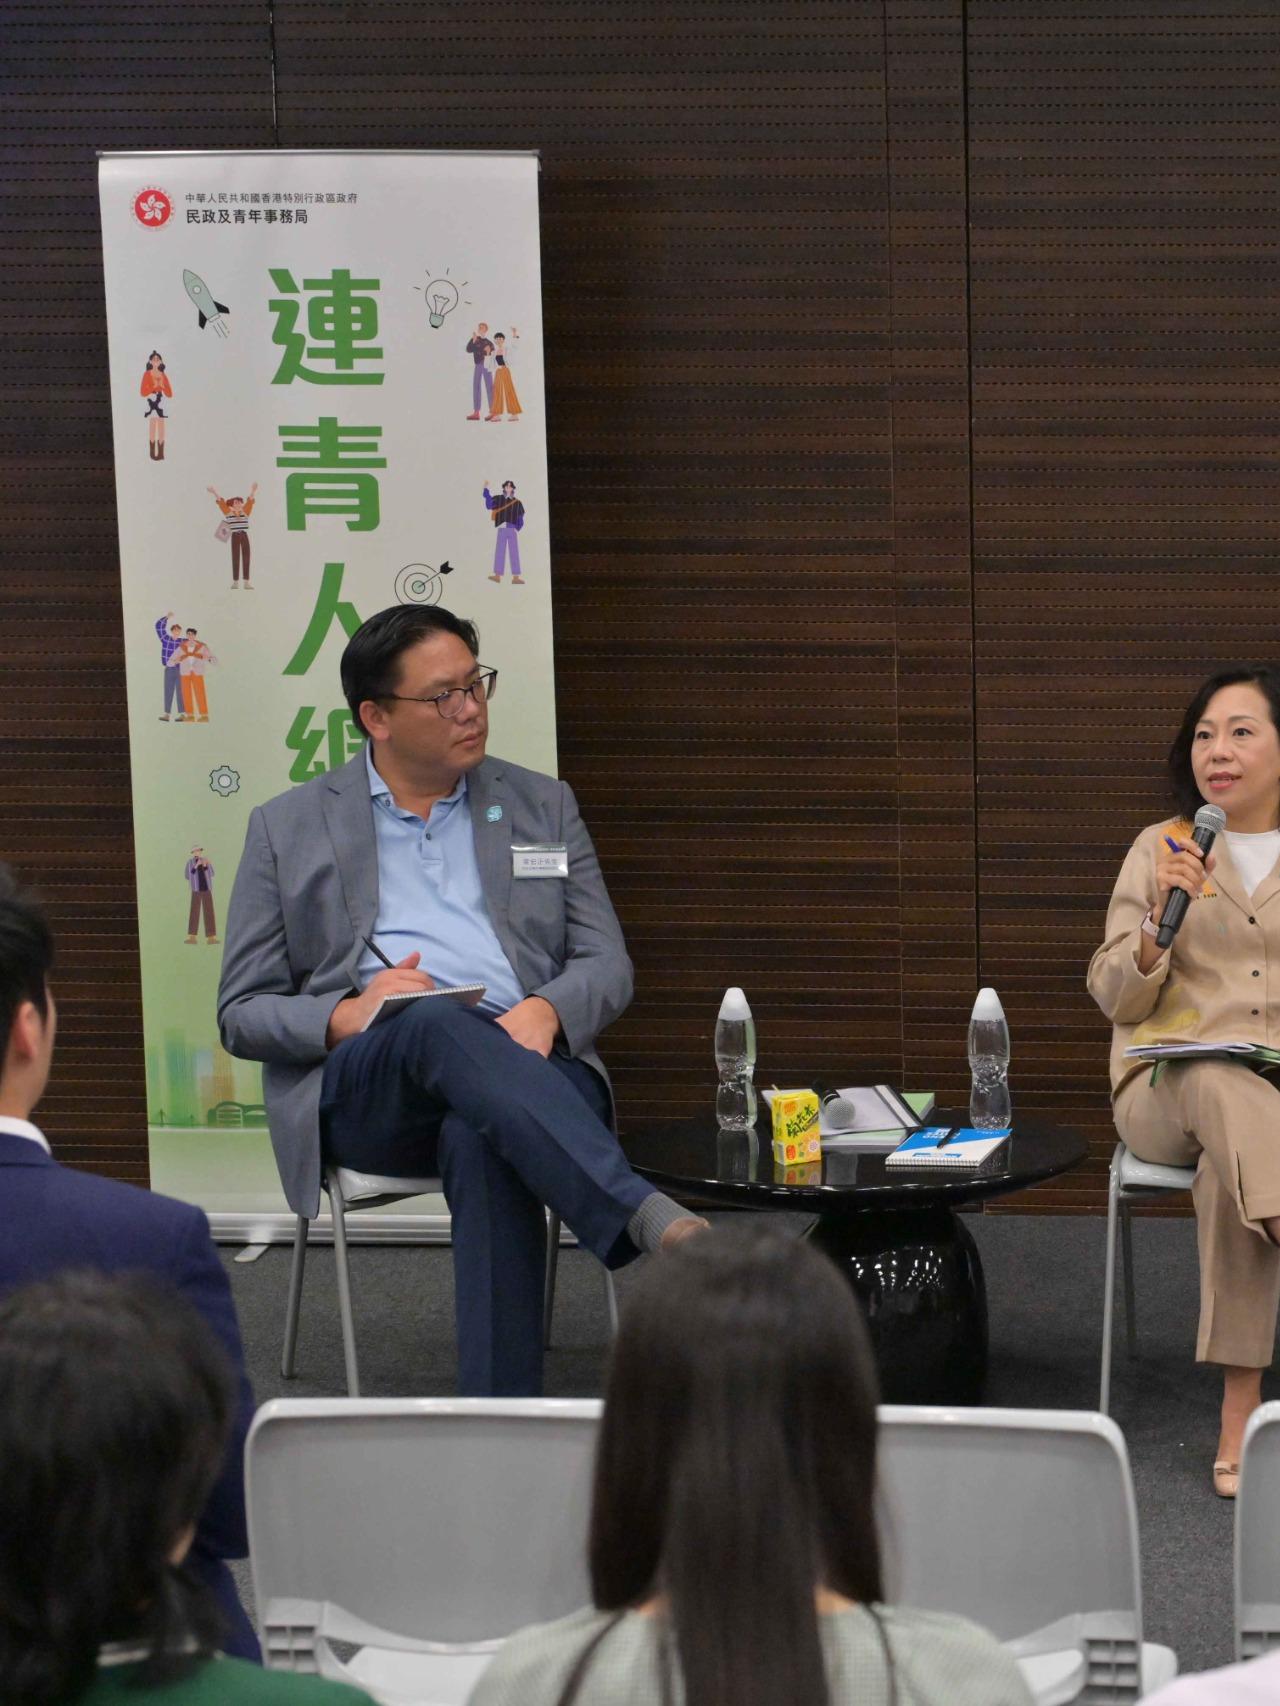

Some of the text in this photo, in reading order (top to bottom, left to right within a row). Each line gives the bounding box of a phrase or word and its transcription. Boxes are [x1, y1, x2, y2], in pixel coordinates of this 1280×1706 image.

[185, 192, 358, 204] 中華人民共和國香港特別行政區政府
[186, 209, 308, 224] 民政及青年事務局
